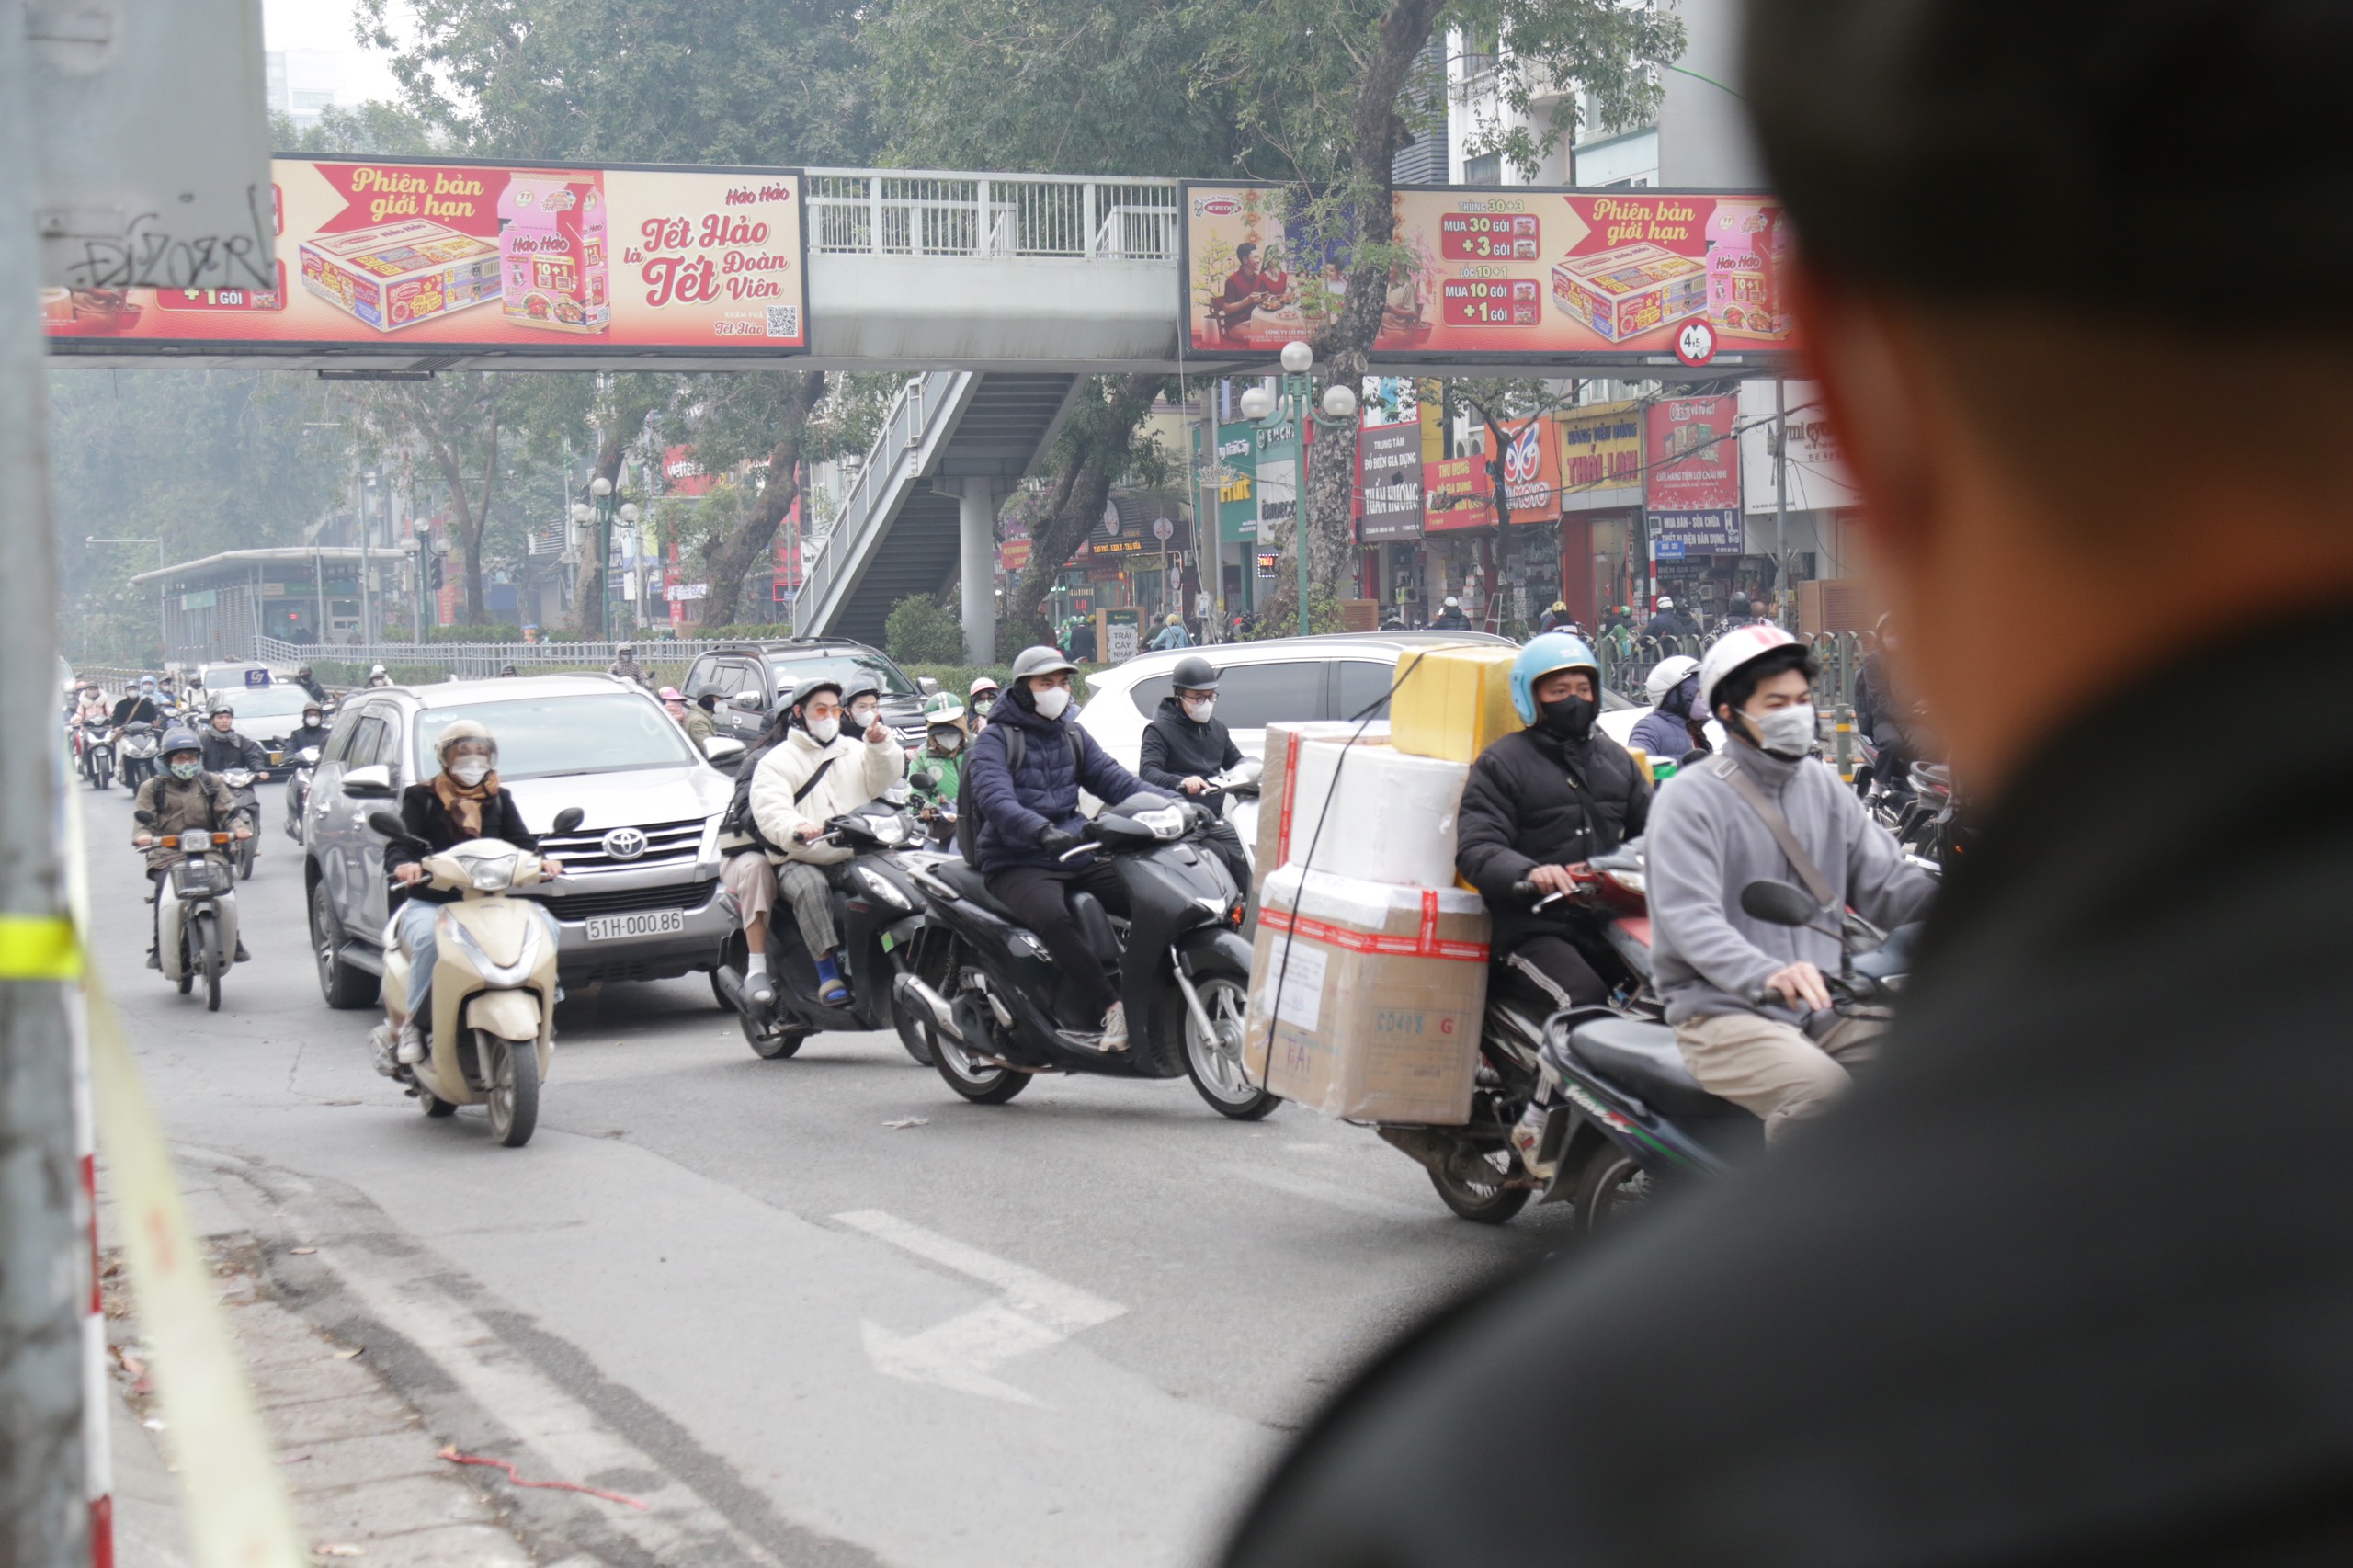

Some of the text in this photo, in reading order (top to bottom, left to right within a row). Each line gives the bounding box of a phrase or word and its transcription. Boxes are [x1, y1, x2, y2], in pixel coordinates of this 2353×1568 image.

[351, 167, 484, 196] Phiên bản
[725, 182, 791, 207] Hảo Hảo
[370, 194, 476, 222] giới hạn
[1459, 199, 1486, 212] THÙNG
[1592, 199, 1695, 222] Phiên bản
[641, 212, 769, 253] Tết Hảo
[1444, 217, 1510, 233] MUA 30 GÓI
[1607, 221, 1688, 245] giới hạn
[513, 232, 570, 253] Hảo Hảo
[1494, 243, 1510, 256] GÓI
[623, 247, 642, 266] là
[722, 250, 789, 276] Đoàn
[1716, 252, 1761, 270] Hảo Hảo
[1460, 264, 1475, 278] LỐC
[642, 255, 721, 310] Tết
[725, 276, 782, 301] Viên
[1445, 282, 1507, 298] MUA 10 GÓI
[220, 290, 243, 305] GÓI
[1491, 308, 1507, 321] GÓI
[714, 322, 763, 336] Tết Hảo
[1374, 436, 1404, 449] TRUNG TÂM
[1567, 443, 1637, 485] THÁI LAN
[1114, 631, 1131, 640] TRÁI
[251, 671, 264, 683] G7
[589, 911, 681, 939] 51H-000.86
